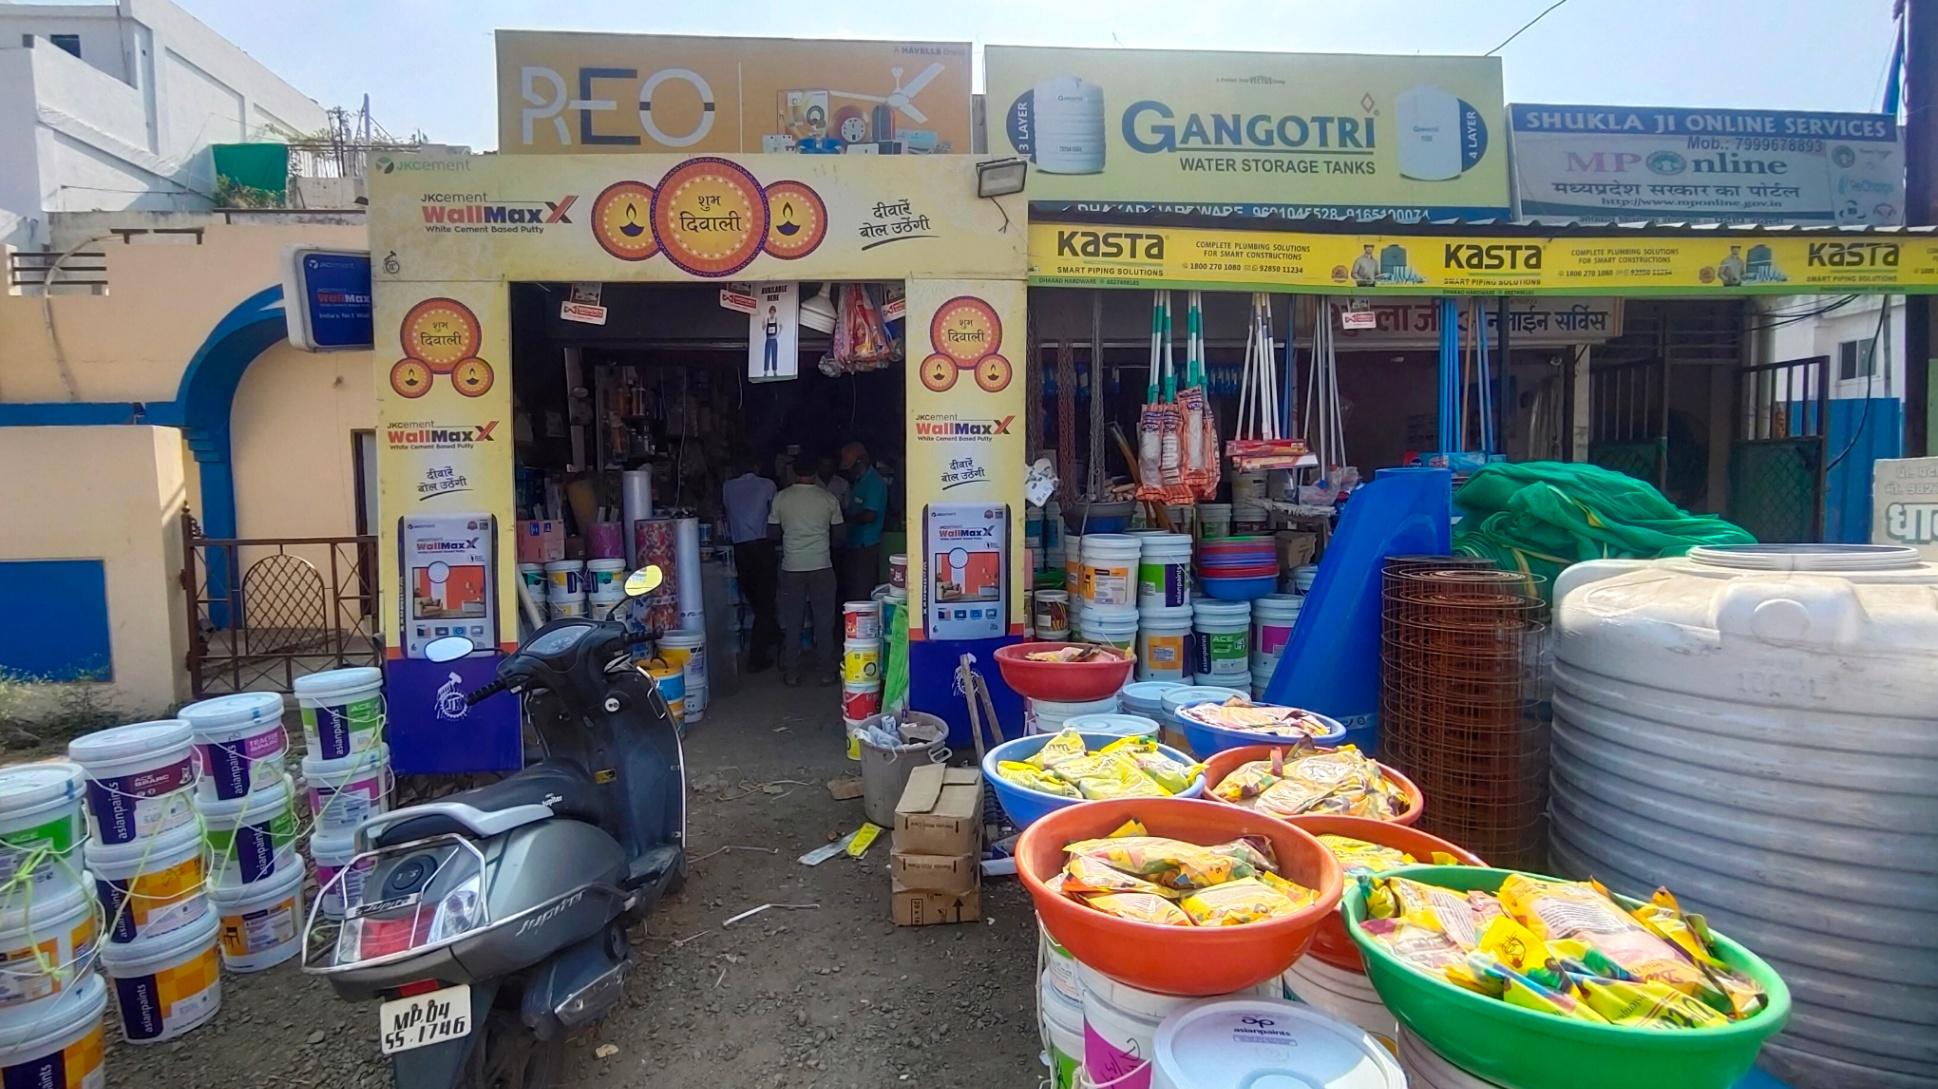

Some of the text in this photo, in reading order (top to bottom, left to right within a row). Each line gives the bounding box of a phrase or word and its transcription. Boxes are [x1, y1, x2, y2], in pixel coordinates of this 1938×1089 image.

[902, 47, 942, 56] HAVELLS
[521, 65, 715, 147] REO
[1017, 102, 1029, 151] 3 LAYER
[1121, 99, 1376, 153] GANGOTRI
[1526, 111, 1886, 138] SHUKLA JI ONLINE SERVICES
[1466, 111, 1478, 159] 4 LAYER
[1736, 137, 1823, 153] 7999678893
[1180, 158, 1376, 174] WATER STORAGE TANKS
[1552, 179, 1800, 199] मध्यप्रदेश सरकार का पोर्टल
[421, 192, 488, 203] JKCement
[697, 195, 721, 212] शुभ
[1601, 198, 1783, 209] http://www.mponline.gov.in
[872, 198, 913, 219] दीवारें
[679, 211, 742, 233] दिवाली
[858, 214, 932, 239] बोल उठेंगी
[425, 226, 545, 235] White Cement Based Putty
[1196, 240, 1310, 254] COMPLETE PLUMBING SOLUTIONS
[1571, 248, 1680, 257] COMPLETE PLUMBING SOLUTIONS
[1220, 250, 1243, 258] SMART
[1246, 252, 1302, 261] CONSTRUCTIONS
[1578, 256, 1672, 265] FOR SMART CONSTRUCTIONS
[1057, 266, 1164, 277] SMART PIPING SOLUTIONS
[1209, 263, 1222, 271] 270
[1282, 266, 1304, 274] 11234
[1443, 278, 1541, 286] SMART PIPING SOLUTIONS
[959, 319, 974, 331] शुभ
[1555, 304, 1609, 333] सर्विस
[432, 321, 449, 333] शुभ
[420, 333, 463, 346] दिवाली
[947, 330, 985, 343] दिवाली
[387, 420, 435, 429] JKCement
[941, 472, 960, 483] बोल
[417, 482, 438, 494] बोल
[331, 708, 345, 755] asianpaints
[228, 744, 243, 794] asianpaints
[108, 781, 128, 840] asianpaints
[139, 984, 154, 1033] asianpaints
